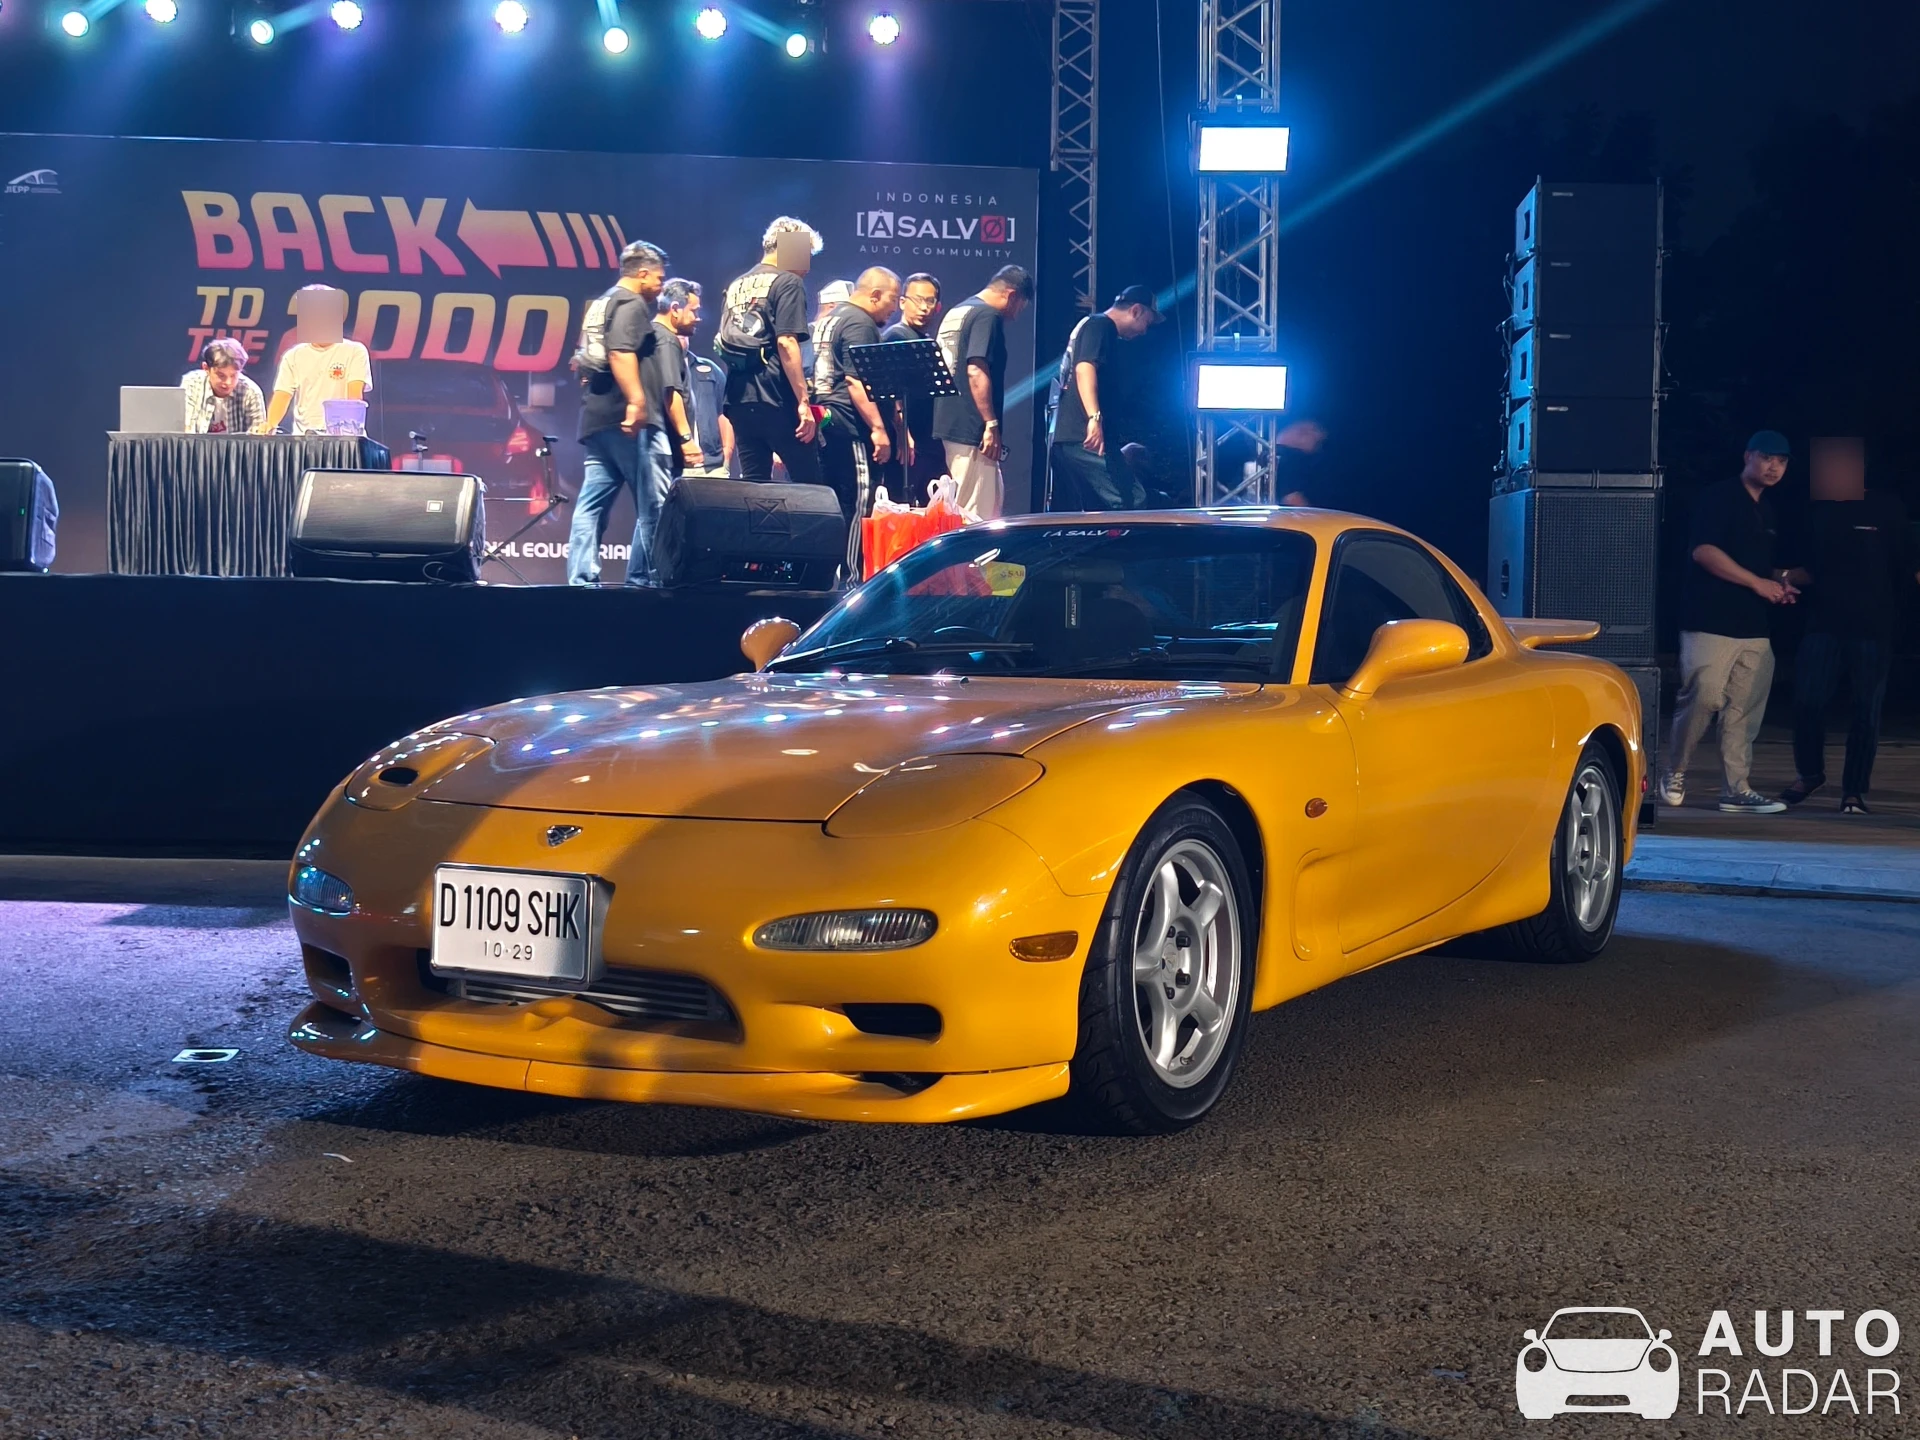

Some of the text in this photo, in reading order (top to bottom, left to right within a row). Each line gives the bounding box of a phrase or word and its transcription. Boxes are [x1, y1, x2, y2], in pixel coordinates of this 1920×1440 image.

[876, 192, 997, 206] INDONESIA
[181, 190, 467, 276] BACK
[859, 245, 1012, 259] AUTO COMMUNITY
[196, 286, 265, 327] TO
[440, 883, 580, 940] D 1109 SHK
